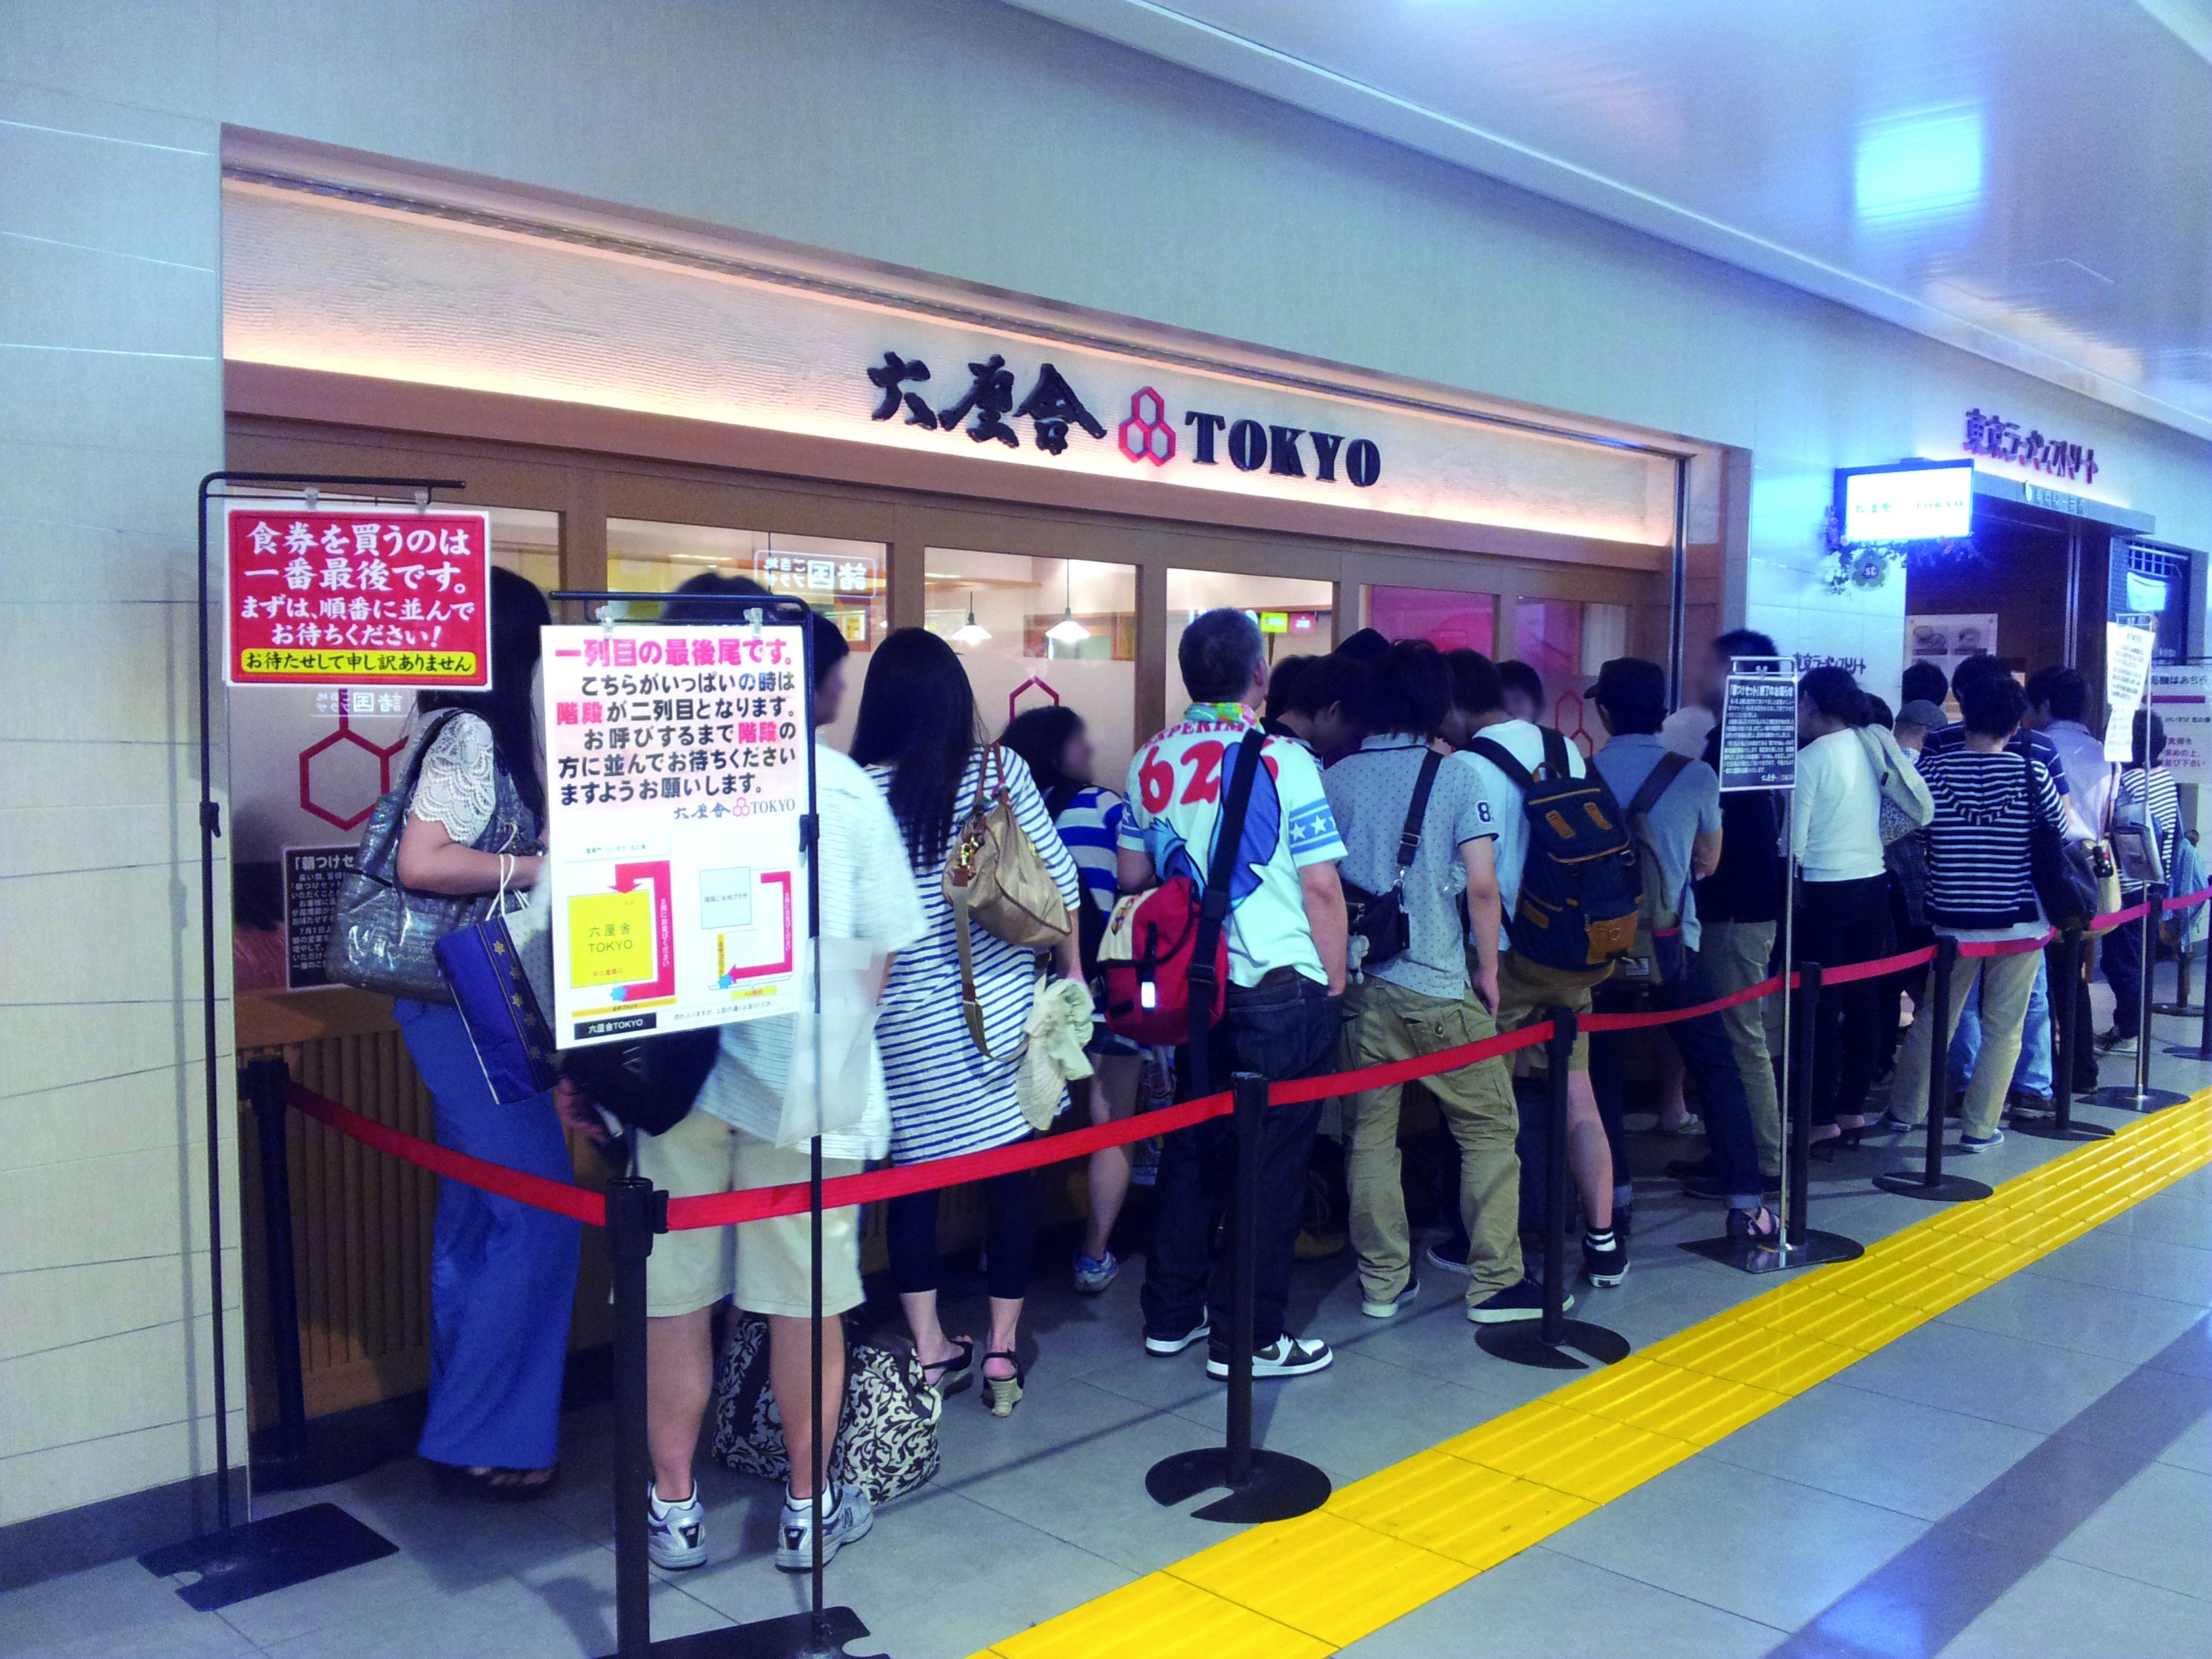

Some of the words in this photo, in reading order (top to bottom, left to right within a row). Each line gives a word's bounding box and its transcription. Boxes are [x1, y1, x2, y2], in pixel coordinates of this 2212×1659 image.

[1185, 410, 1382, 487] TOKYO
[245, 520, 472, 556] 食券を買うのは
[244, 557, 466, 594] 一番最後です。
[241, 594, 475, 621] まずは、順番に並んで
[246, 652, 472, 672] お待たせして申し訳ありません
[555, 638, 792, 667] 一列目の最後尾です。
[581, 671, 795, 696] こちらがいっぱいの時は
[556, 697, 794, 725] 階段が二列目となります。
[584, 722, 796, 750] お呼びするまで階段の
[558, 747, 796, 779] 方に並んでお待ちください
[560, 773, 762, 806] ますようお願いします。
[750, 798, 795, 815] TOKYO
[1476, 800, 1491, 824] 8
[588, 939, 633, 954] TOKYO
